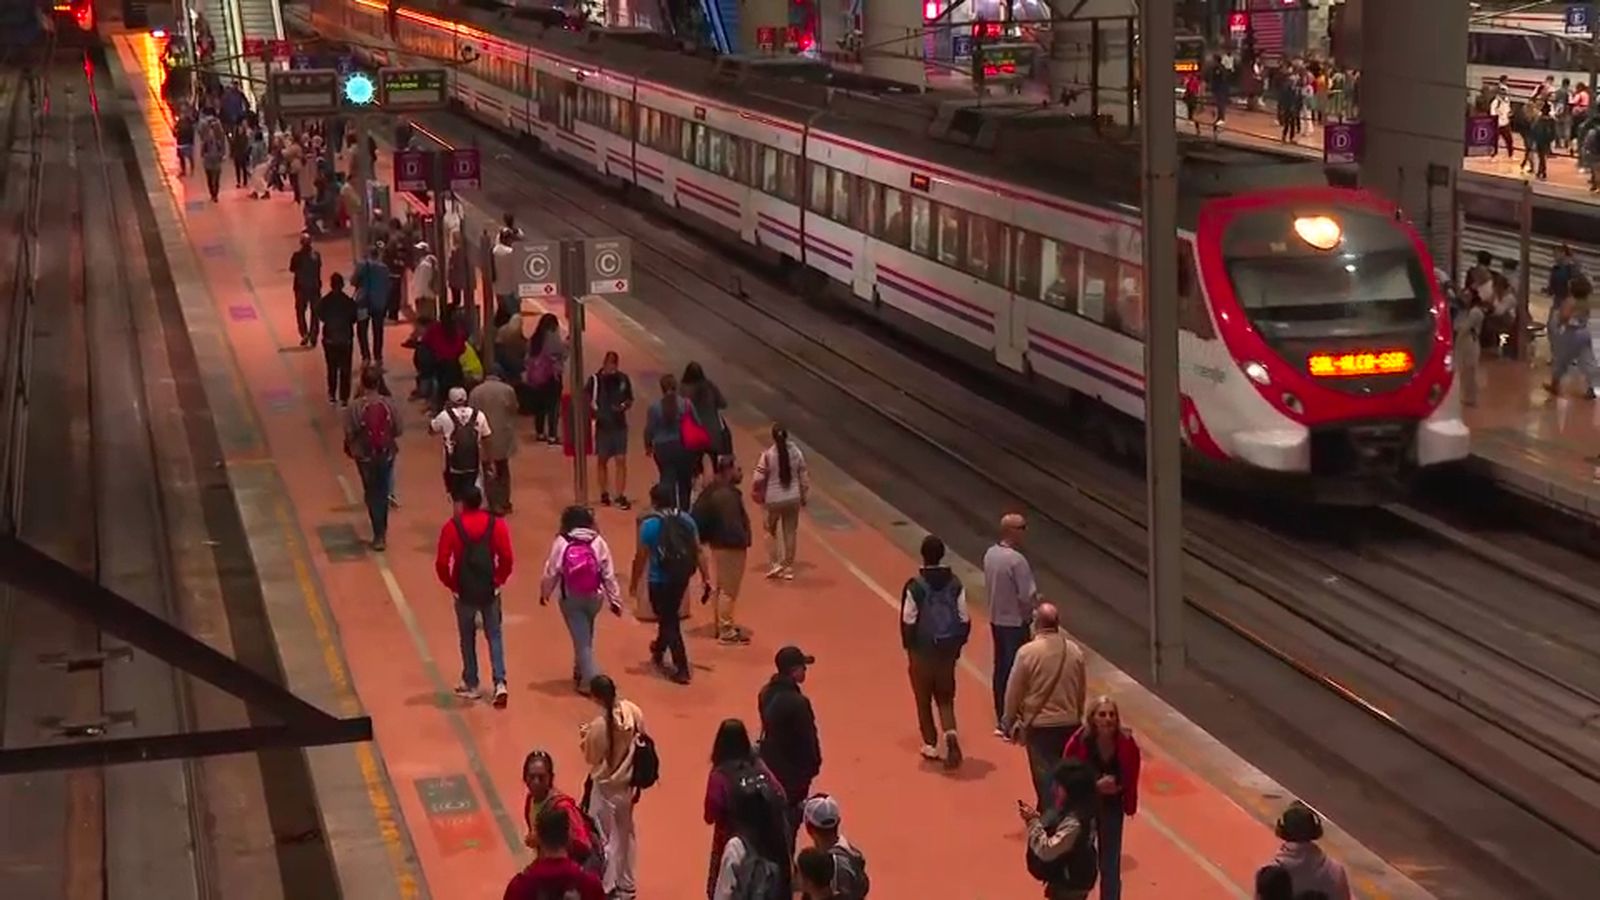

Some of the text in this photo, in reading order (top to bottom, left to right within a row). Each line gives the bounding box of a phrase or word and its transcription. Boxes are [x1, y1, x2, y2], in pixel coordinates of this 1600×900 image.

[1336, 134, 1347, 148] D
[1477, 127, 1488, 141] D
[406, 161, 417, 176] D
[458, 160, 470, 174] D
[529, 257, 545, 276] C
[600, 253, 617, 273] C
